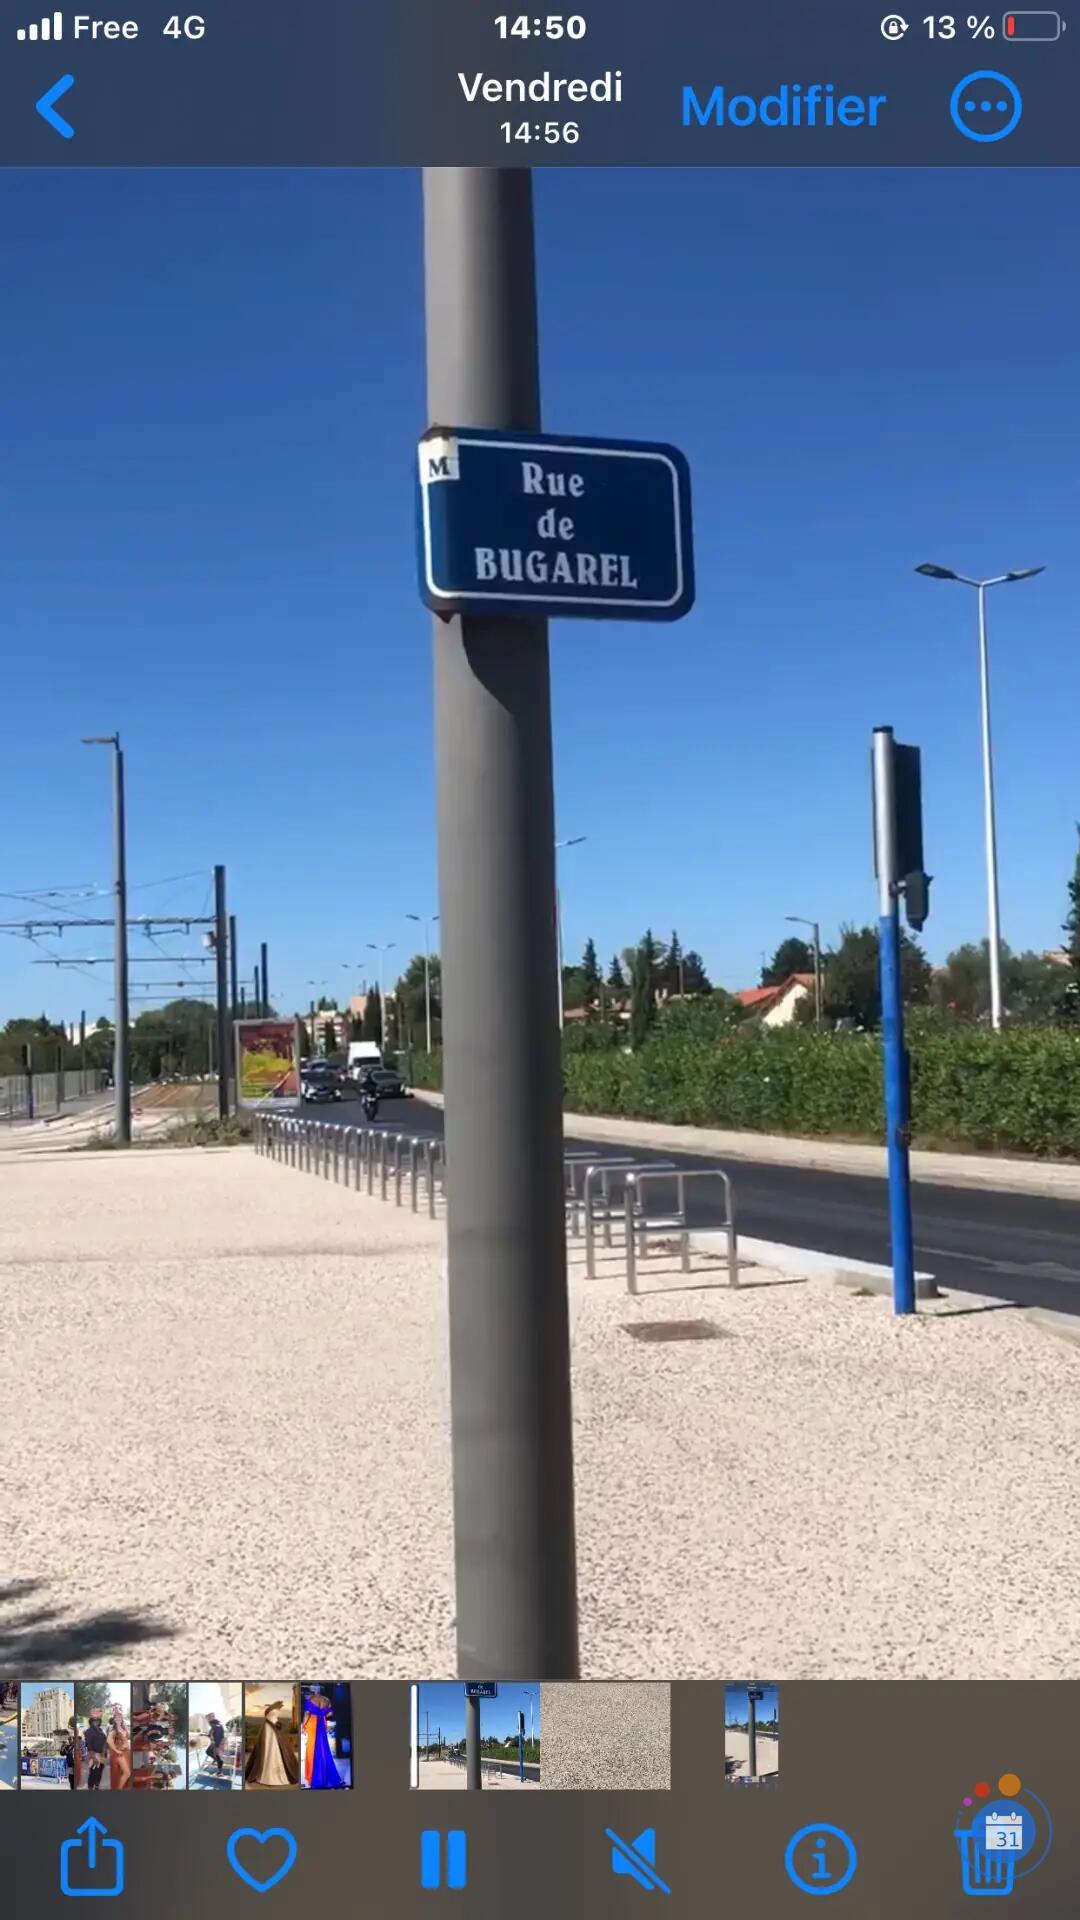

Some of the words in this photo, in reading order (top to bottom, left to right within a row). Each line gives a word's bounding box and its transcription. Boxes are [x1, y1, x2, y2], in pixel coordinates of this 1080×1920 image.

[428, 457, 451, 478] M
[521, 461, 585, 498] Rue
[537, 508, 575, 541] de
[475, 547, 638, 589] BUGAREL
